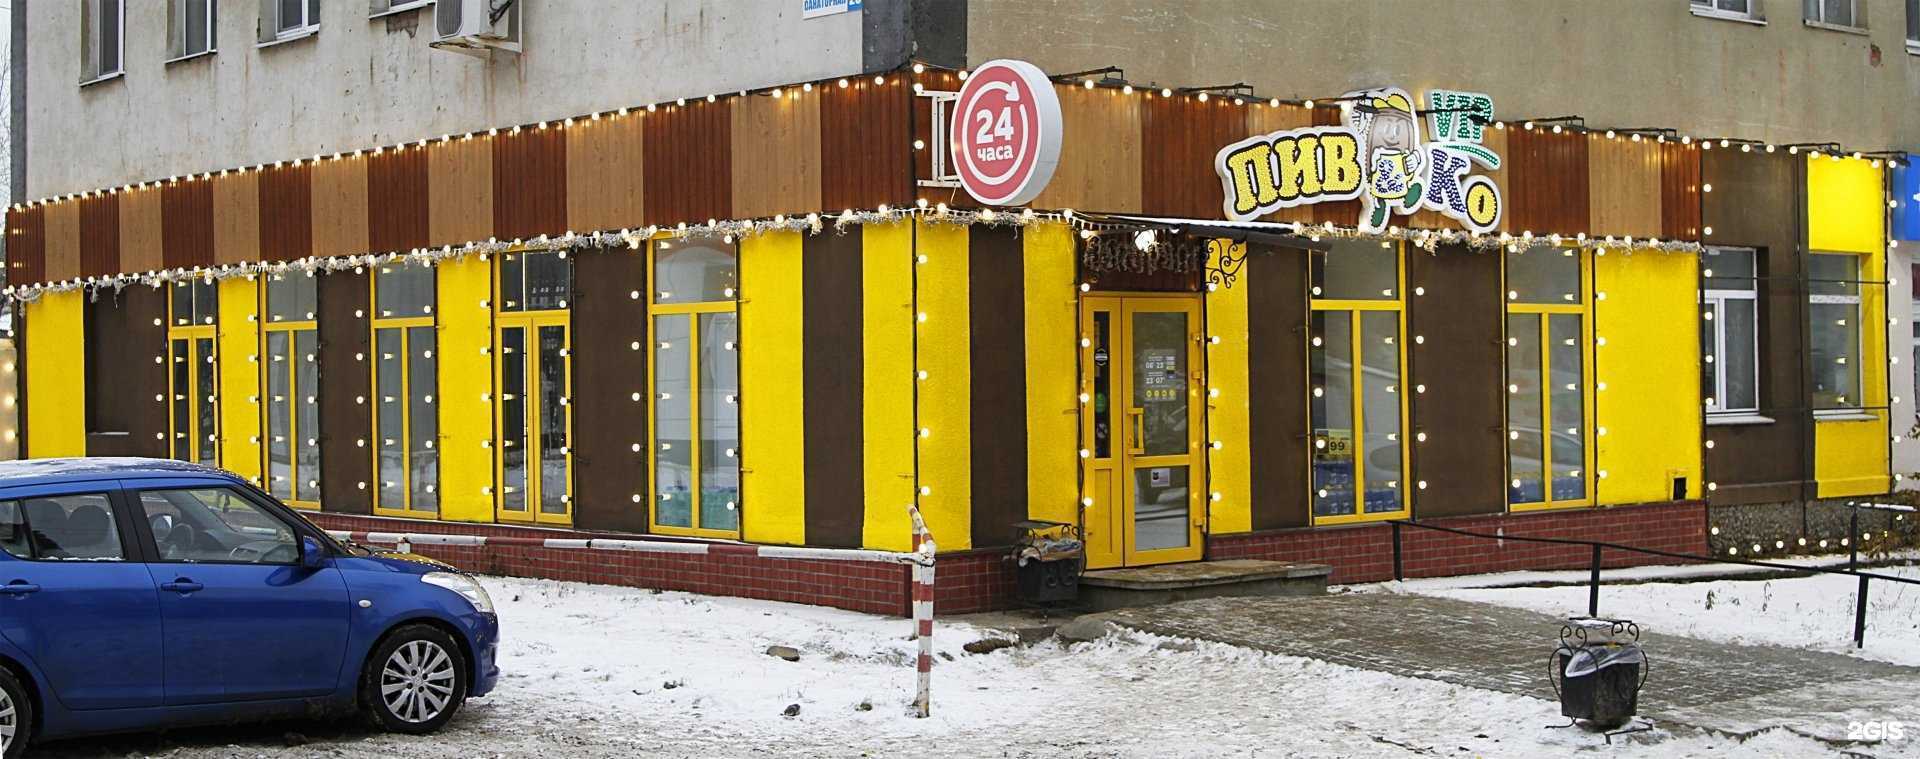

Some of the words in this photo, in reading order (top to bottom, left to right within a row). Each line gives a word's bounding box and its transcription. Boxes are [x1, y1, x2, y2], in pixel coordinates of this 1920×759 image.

[975, 106, 1015, 145] 24
[1432, 92, 1492, 140] VIP
[977, 144, 1014, 162] часа
[1226, 132, 1362, 215] ПИВ
[1329, 441, 1345, 451] 99
